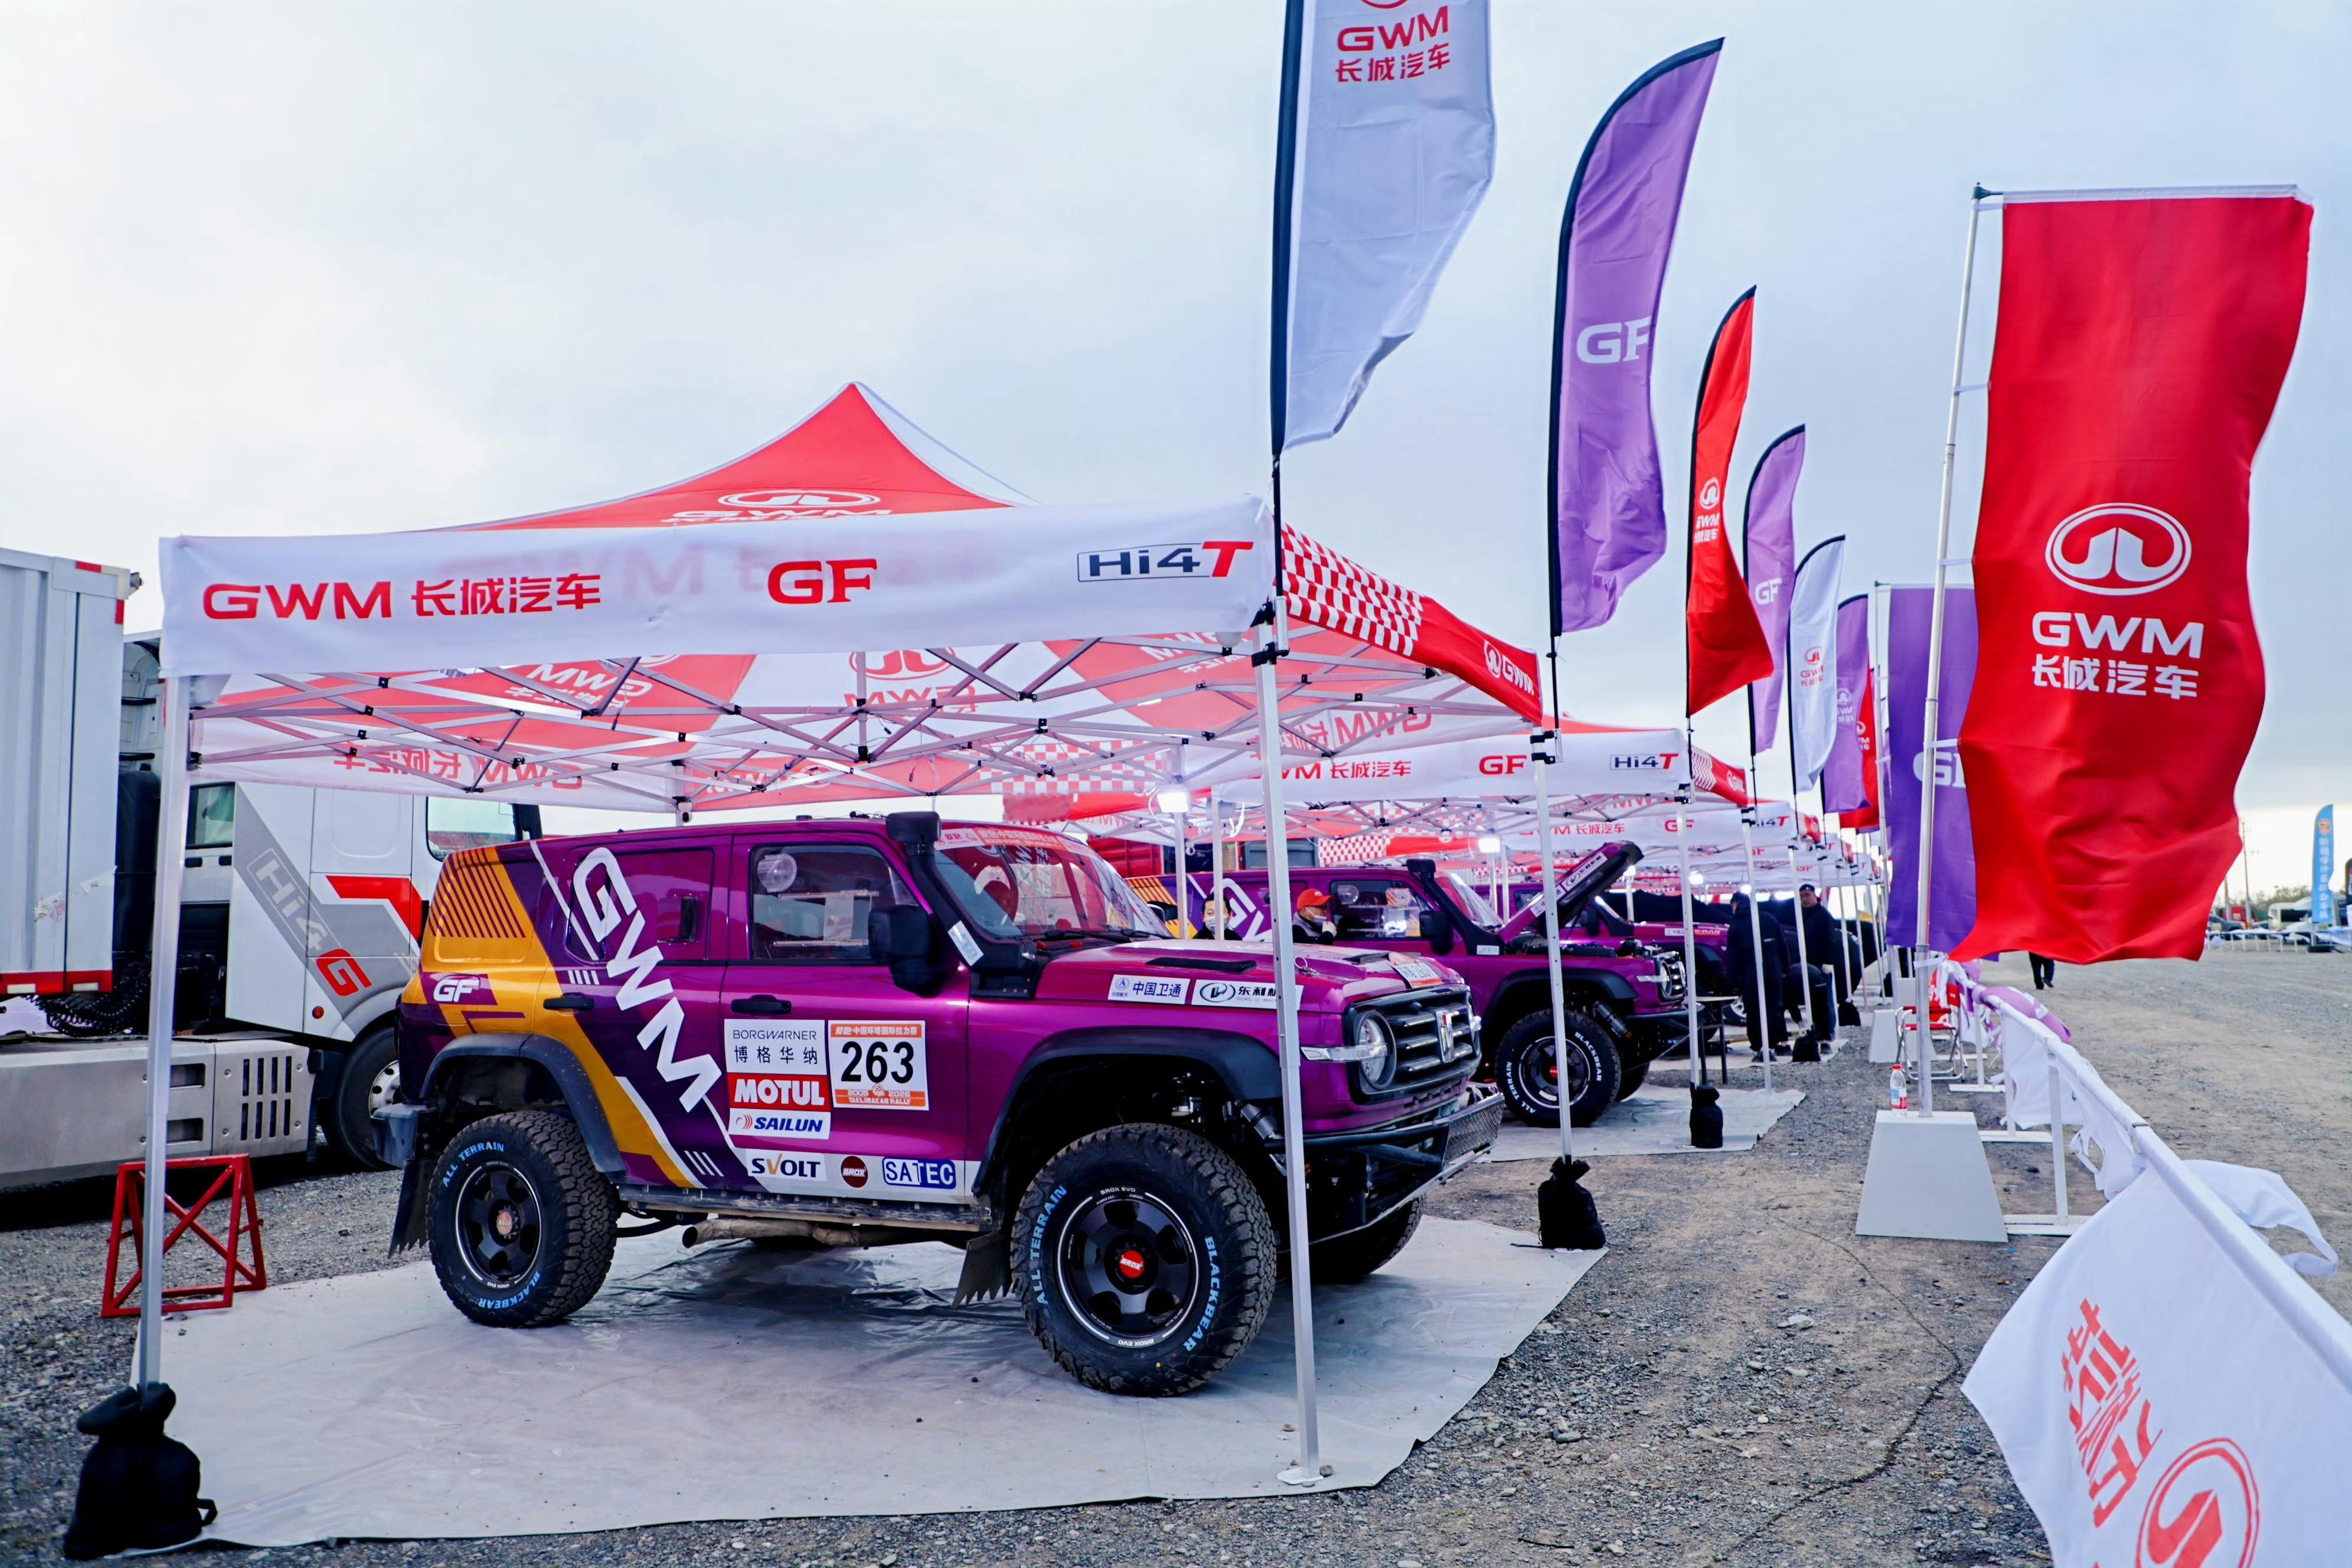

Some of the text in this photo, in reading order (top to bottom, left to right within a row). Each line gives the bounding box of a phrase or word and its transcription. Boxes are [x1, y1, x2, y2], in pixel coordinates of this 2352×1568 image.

[1337, 5, 1449, 52] GWM
[1335, 43, 1450, 82] 长城汽车
[1576, 315, 1652, 364] GF
[1088, 541, 1253, 577] Hi4T
[202, 581, 392, 620] GWM
[411, 573, 601, 616] 长城汽车
[767, 558, 877, 605] GF
[1755, 577, 1782, 605] GF
[2032, 611, 2204, 659] GWM
[1502, 654, 1534, 696] GWM
[2032, 654, 2199, 700] 长城汽车
[1329, 761, 1412, 779] 长城汽车
[1479, 755, 1527, 775] GF
[1614, 753, 1679, 769] Hi4T
[433, 979, 479, 1002] GF
[573, 847, 722, 1113] GWM
[1132, 981, 1181, 998] 中国卫通
[733, 1030, 816, 1040] BORGWARNER
[841, 1041, 914, 1083] 263
[1574, 1031, 1602, 1082] BLACKBEAR
[734, 1079, 825, 1106] MOTUL
[1506, 1061, 1536, 1113] ALL TERRAIN
[754, 1116, 823, 1133] SAILUN
[442, 1164, 459, 1188] ALL
[458, 1141, 505, 1161] TERRAIN
[752, 1154, 821, 1178] SVOLT
[842, 1167, 866, 1178] BROX
[886, 1161, 955, 1185] SATEC
[1100, 1187, 1120, 1195] BROX
[1030, 1185, 1068, 1305] ALL TERRAIN
[478, 1270, 541, 1309] BLACKBEAR
[1182, 1236, 1221, 1352] BLACKBEAR
[1134, 1338, 1155, 1347] BROX
